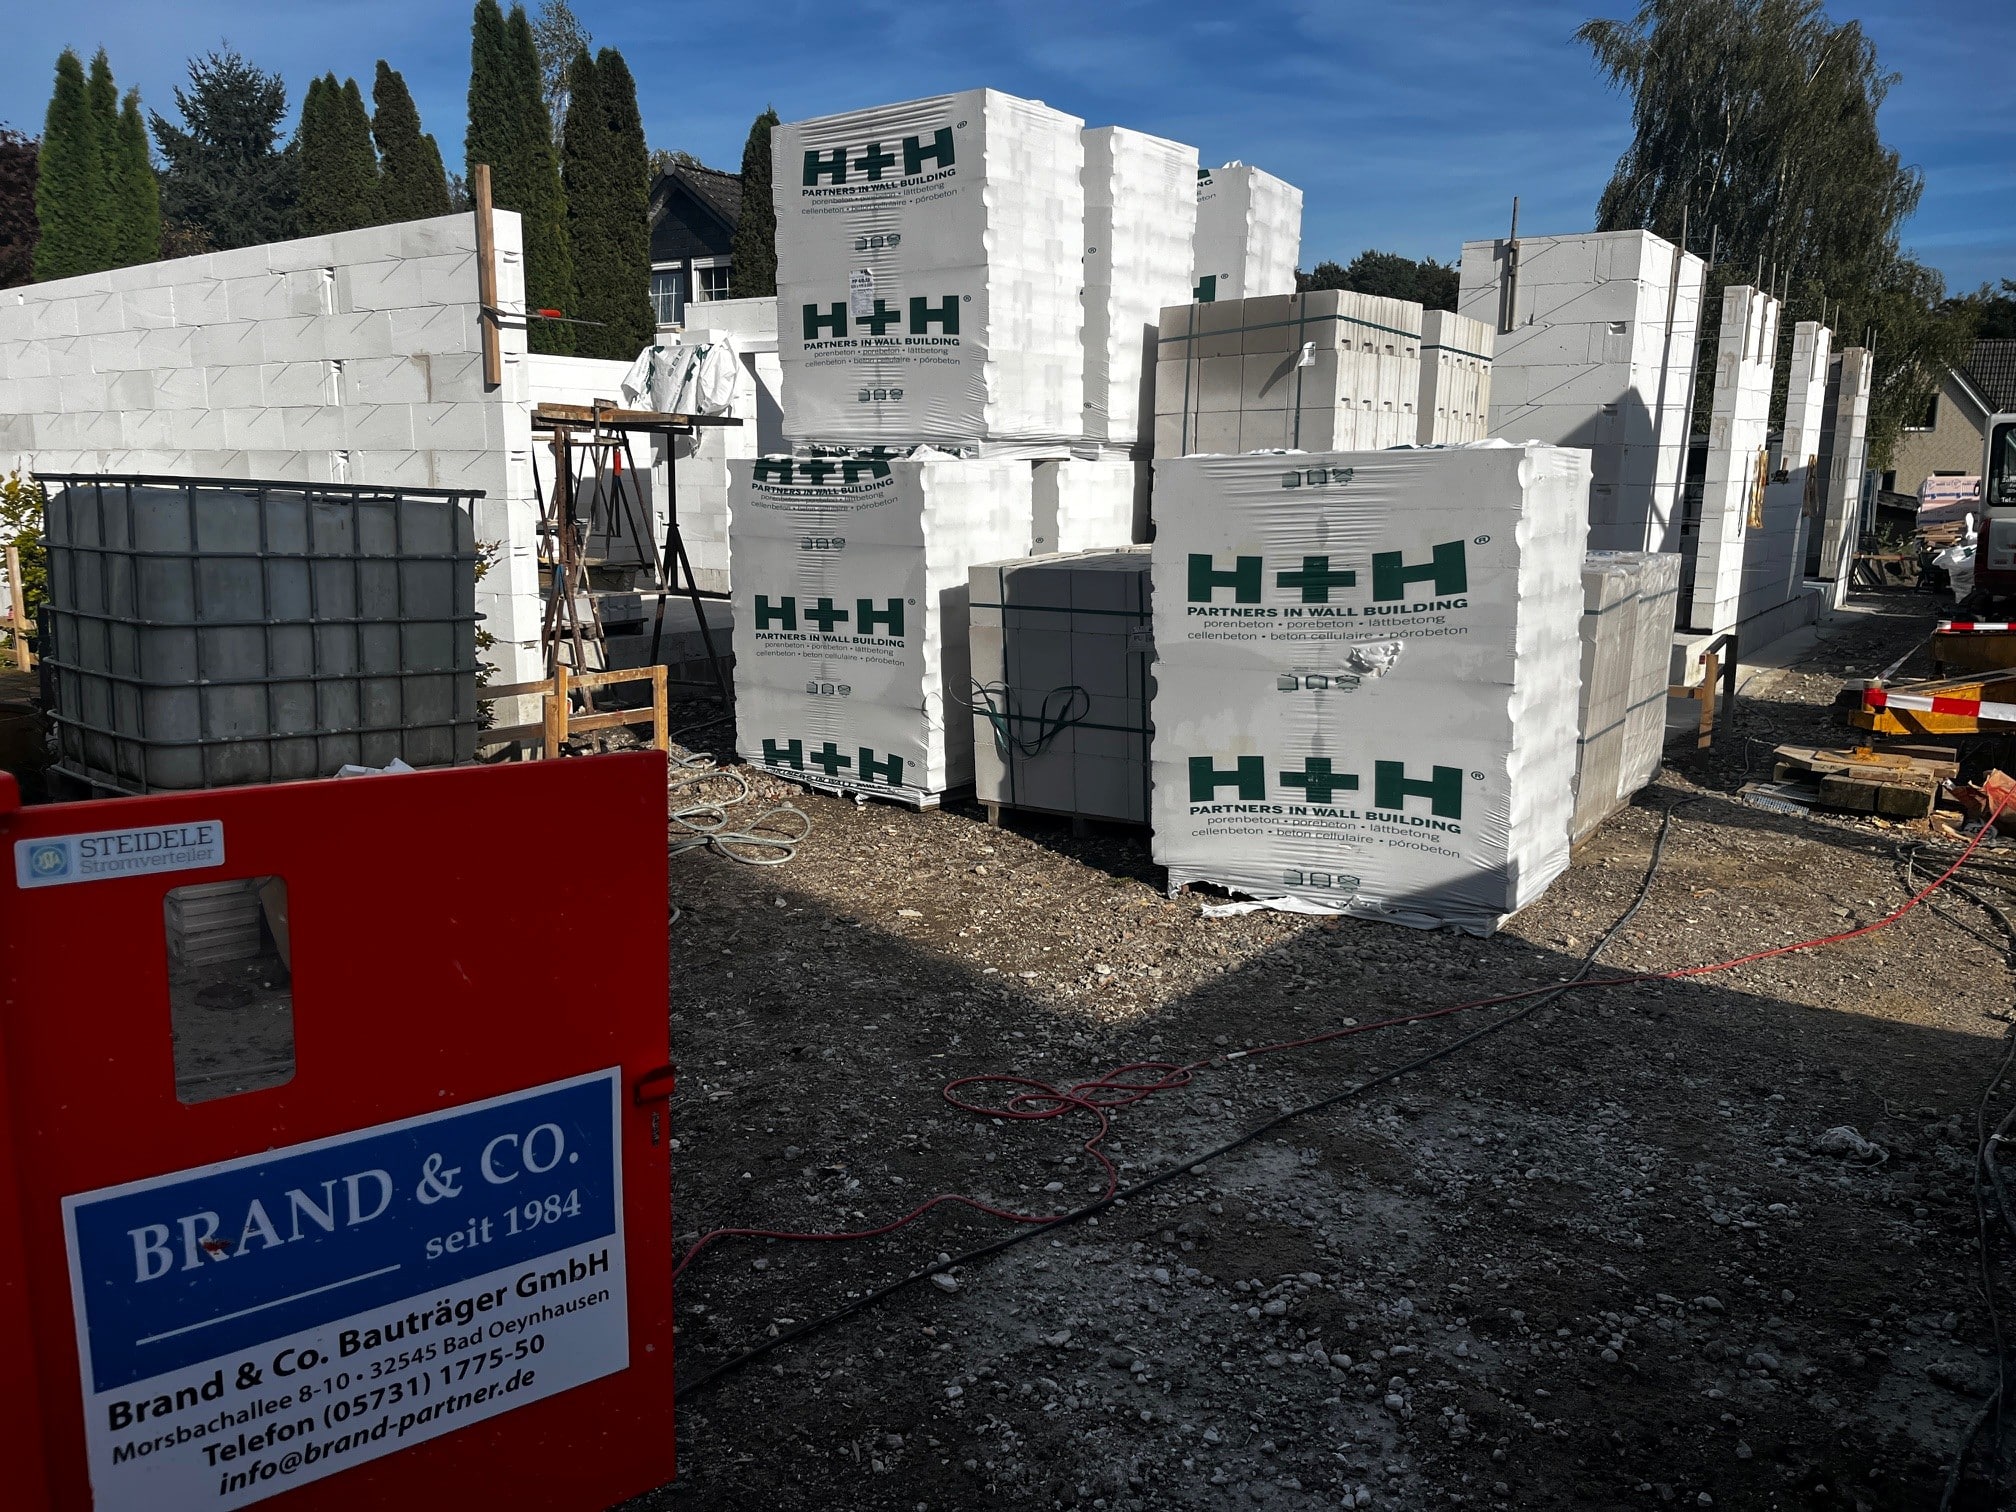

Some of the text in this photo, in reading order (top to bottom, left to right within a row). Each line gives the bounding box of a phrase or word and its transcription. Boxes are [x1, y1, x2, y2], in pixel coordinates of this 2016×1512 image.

[802, 168, 956, 196] PARTNERS IN WALL BUILDING
[802, 207, 844, 215] cellenbeton
[804, 340, 858, 350] PARTNERS
[873, 338, 902, 346] WALL
[905, 337, 960, 347] BUILDING
[814, 349, 856, 359] porenbeton
[907, 346, 949, 356] lättbetong
[805, 359, 846, 368] cellenbeton
[752, 483, 801, 495] PARTNERS
[841, 477, 894, 494] BUILDING
[1187, 599, 1468, 617] PARTNERS IN WALL BUILDING
[1187, 626, 1468, 641] cellenbeton beton cellulaire pórobeton
[1204, 615, 1446, 630] porenbeton porebeton lättbetong
[755, 632, 806, 641] PARTNERS
[822, 635, 850, 643] WALL
[852, 637, 905, 648] BUILDING
[812, 643, 848, 651] porebeton
[825, 652, 858, 661] cellulaire
[1190, 804, 1461, 834] PARTNERS IN WALL BUILDING
[1208, 816, 1440, 842] porenbeton porebeton lättbetong
[81, 826, 213, 857] STEIDELE
[1192, 828, 1460, 858] cellenbeton beton cellulaire pórobeton
[81, 848, 214, 874] Stromverteiler
[127, 1172, 393, 1283] BRAND
[416, 1152, 463, 1204] &
[480, 1123, 579, 1184] CO.
[425, 1189, 581, 1260] seit 1984
[108, 1249, 609, 1431] Brand & Co. Bauträger GmbH
[113, 1288, 610, 1465] Morsbachallee 8-10 32545 Bad Oeynhausen
[202, 1334, 545, 1467] Telefon (05731) 1775-50
[219, 1368, 536, 1496] info@brand-partner.de
